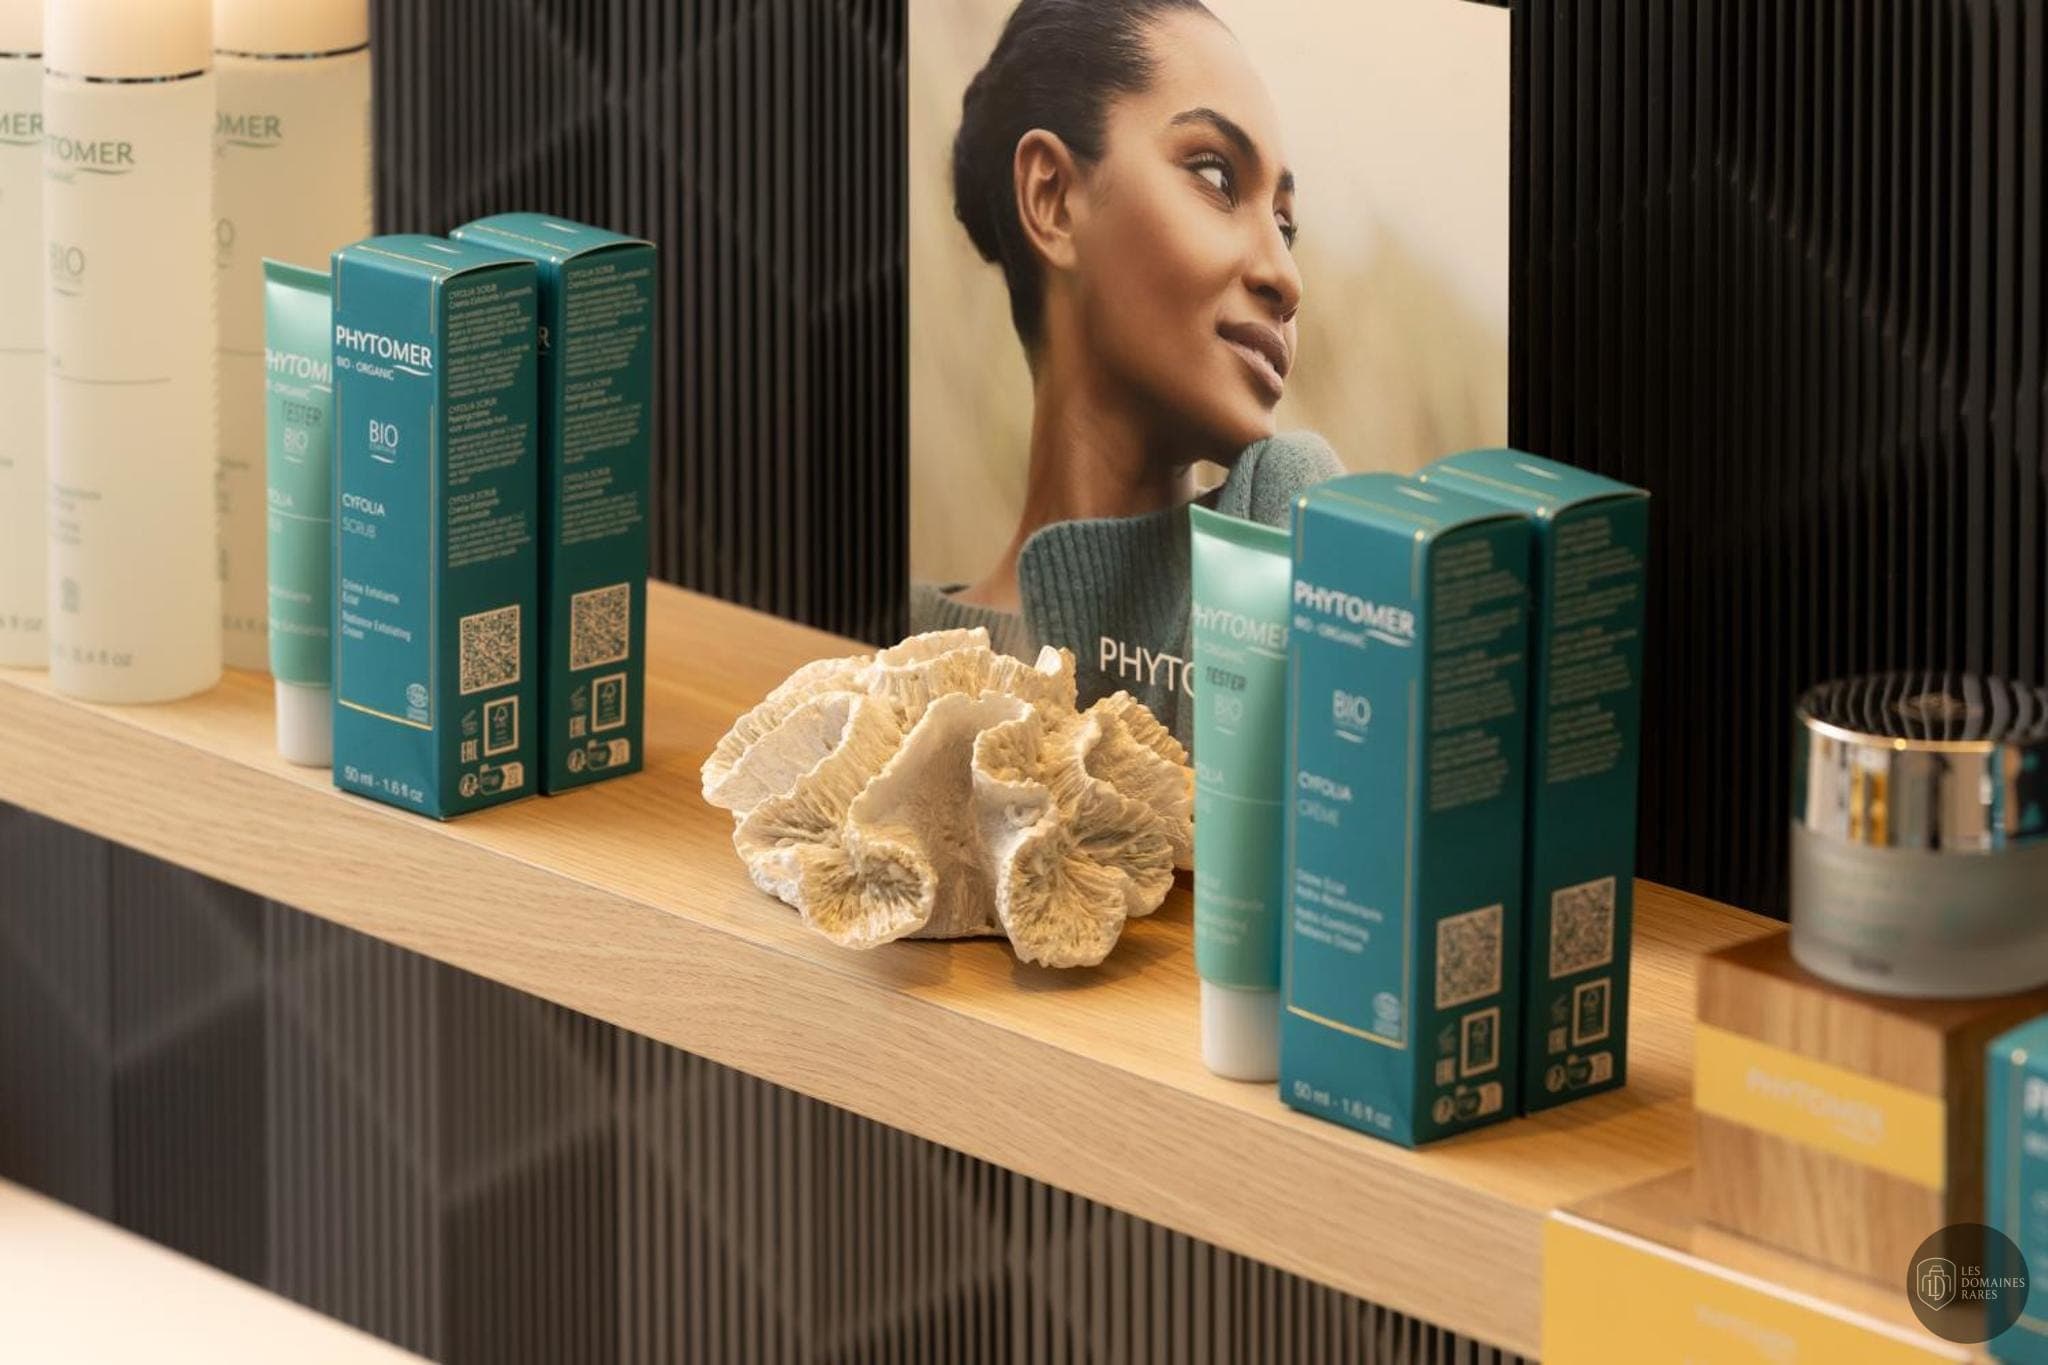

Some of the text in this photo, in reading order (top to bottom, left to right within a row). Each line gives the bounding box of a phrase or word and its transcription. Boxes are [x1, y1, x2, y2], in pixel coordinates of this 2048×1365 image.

[265, 347, 333, 384] HYTOM
[336, 325, 433, 369] PHYTOMER
[283, 400, 323, 427] TESTER
[369, 419, 399, 449] BIO
[1294, 579, 1416, 639] PHYTOMER
[1205, 666, 1248, 691] TESTER
[1333, 689, 1371, 726] BIO
